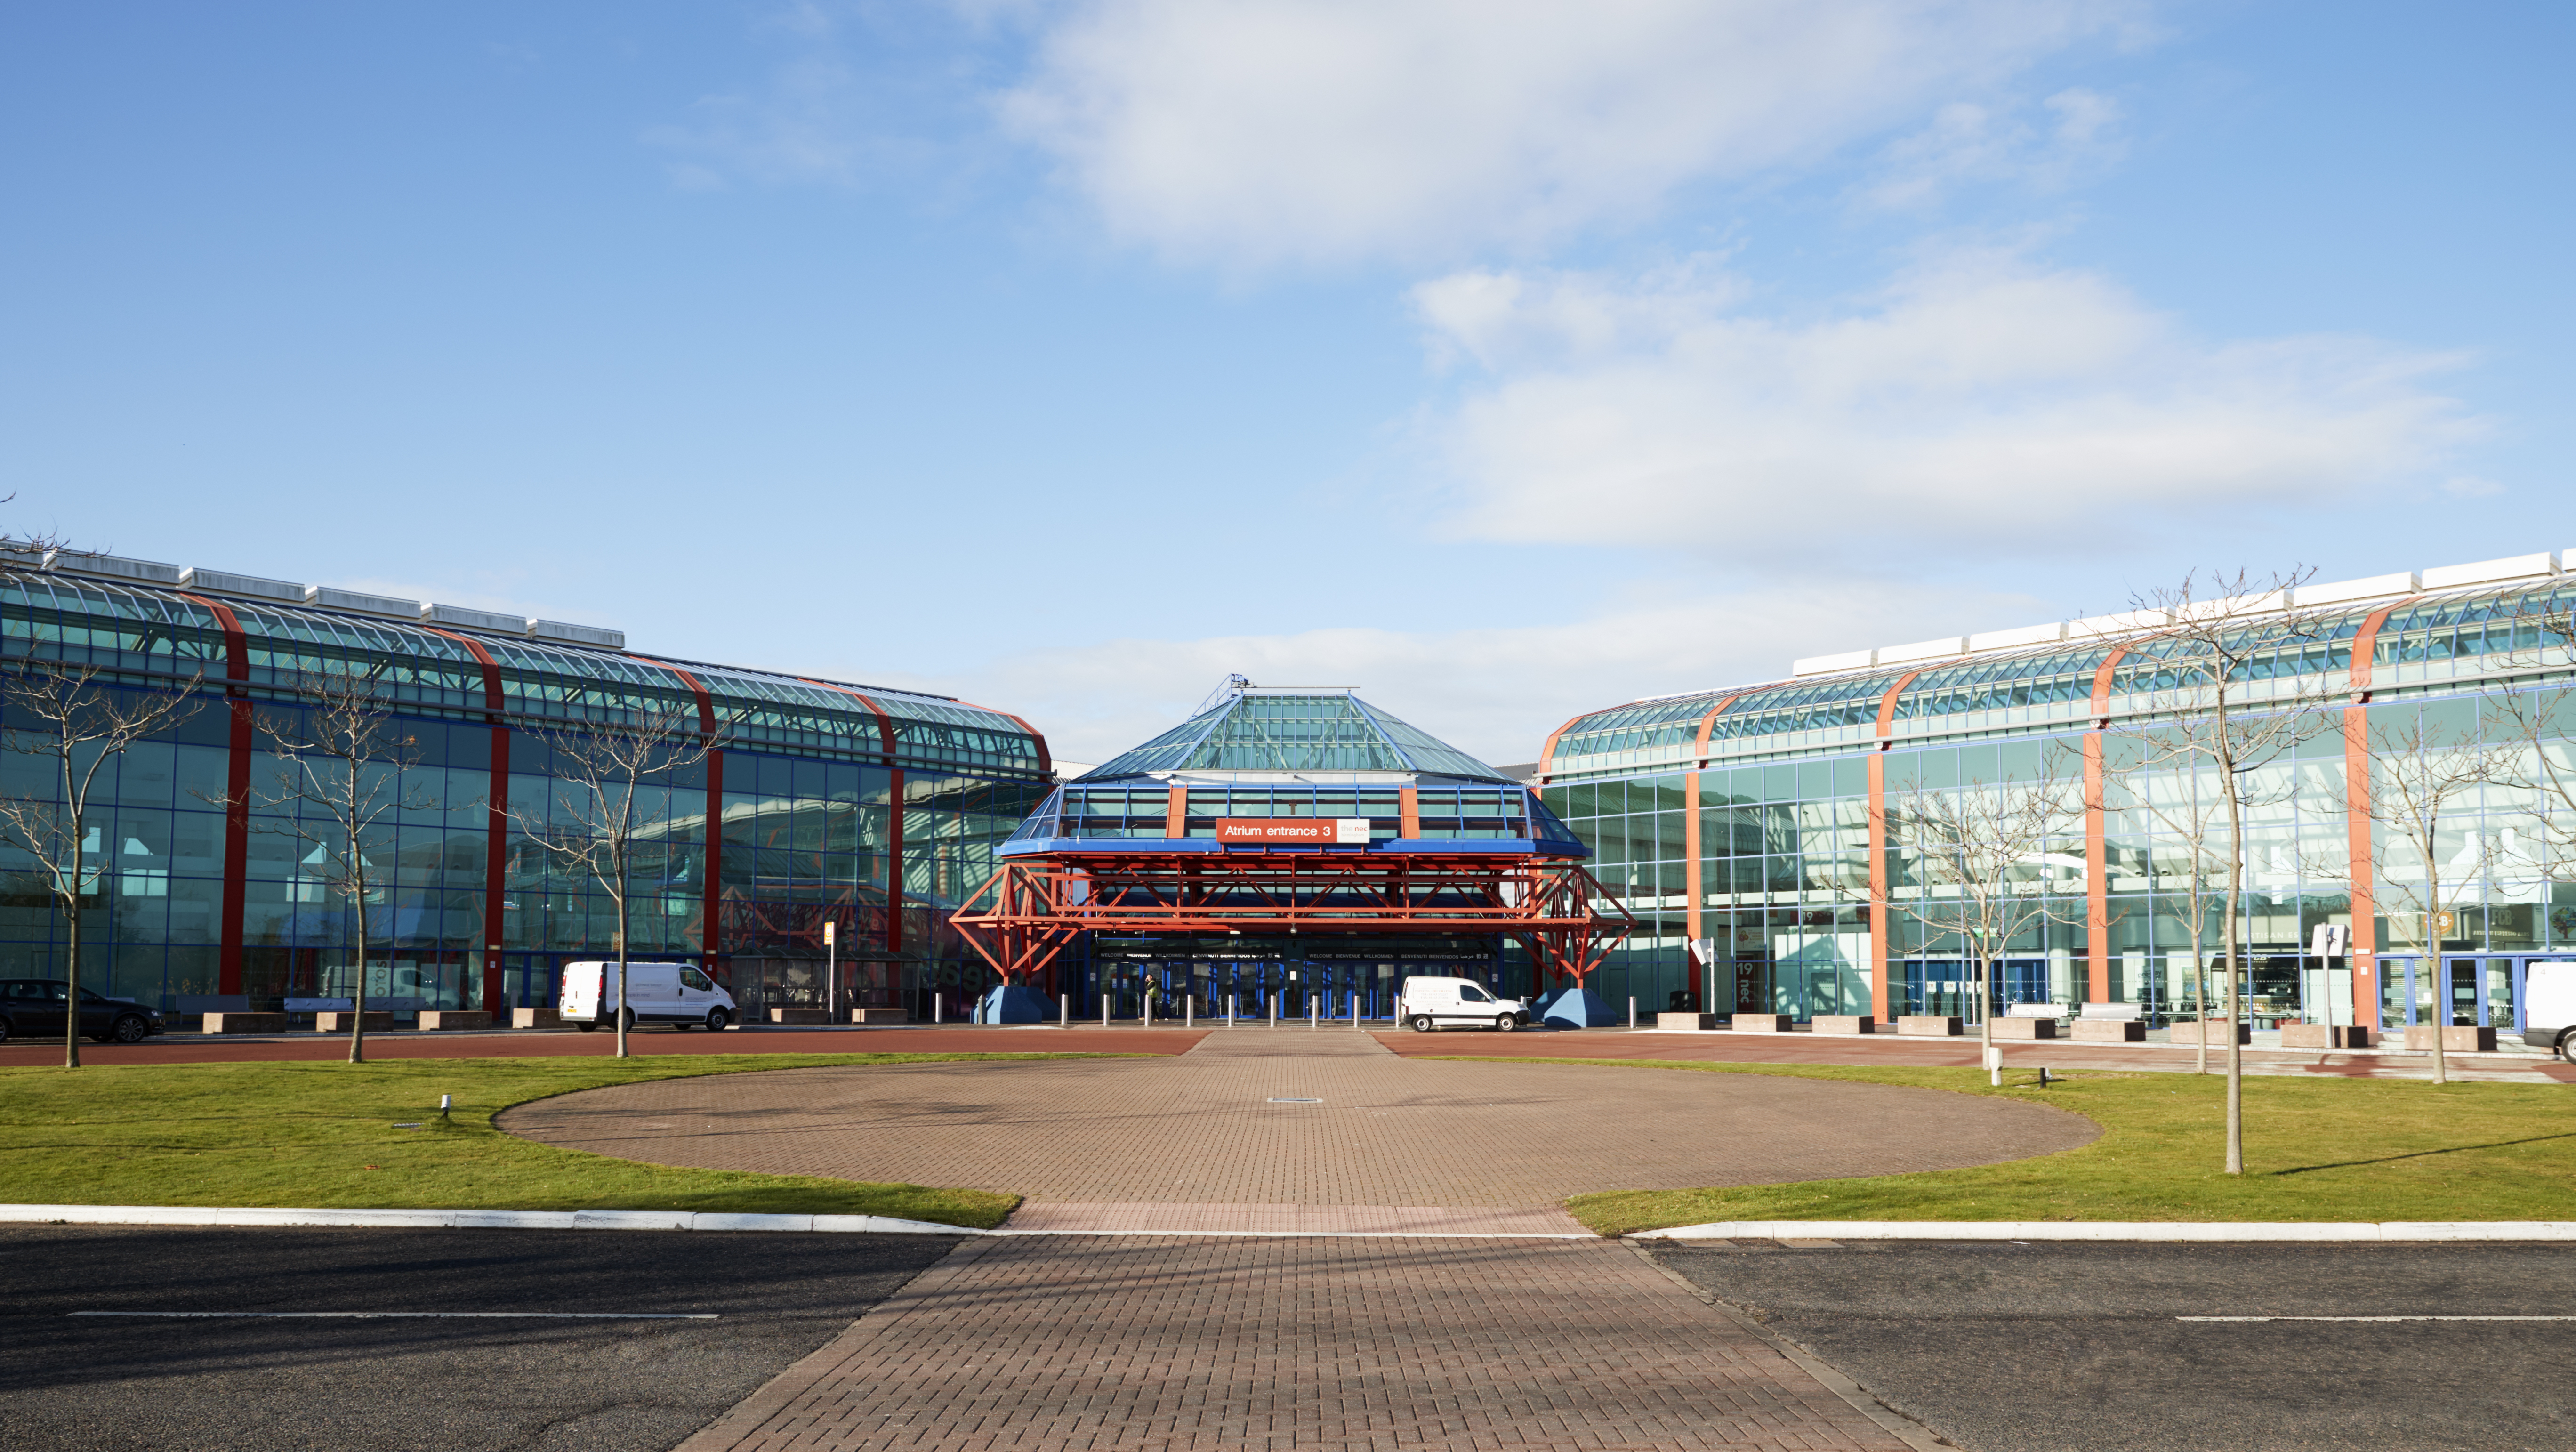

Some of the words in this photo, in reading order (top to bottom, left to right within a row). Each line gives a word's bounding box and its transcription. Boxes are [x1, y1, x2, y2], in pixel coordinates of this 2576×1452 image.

[1225, 826, 1262, 836] Atrium
[1267, 826, 1318, 836] entrance
[1323, 826, 1331, 836] 3
[1803, 912, 1813, 921] 19
[2492, 910, 2512, 926] FCB
[1737, 962, 1753, 975] 19
[1740, 979, 1749, 1004] nec
